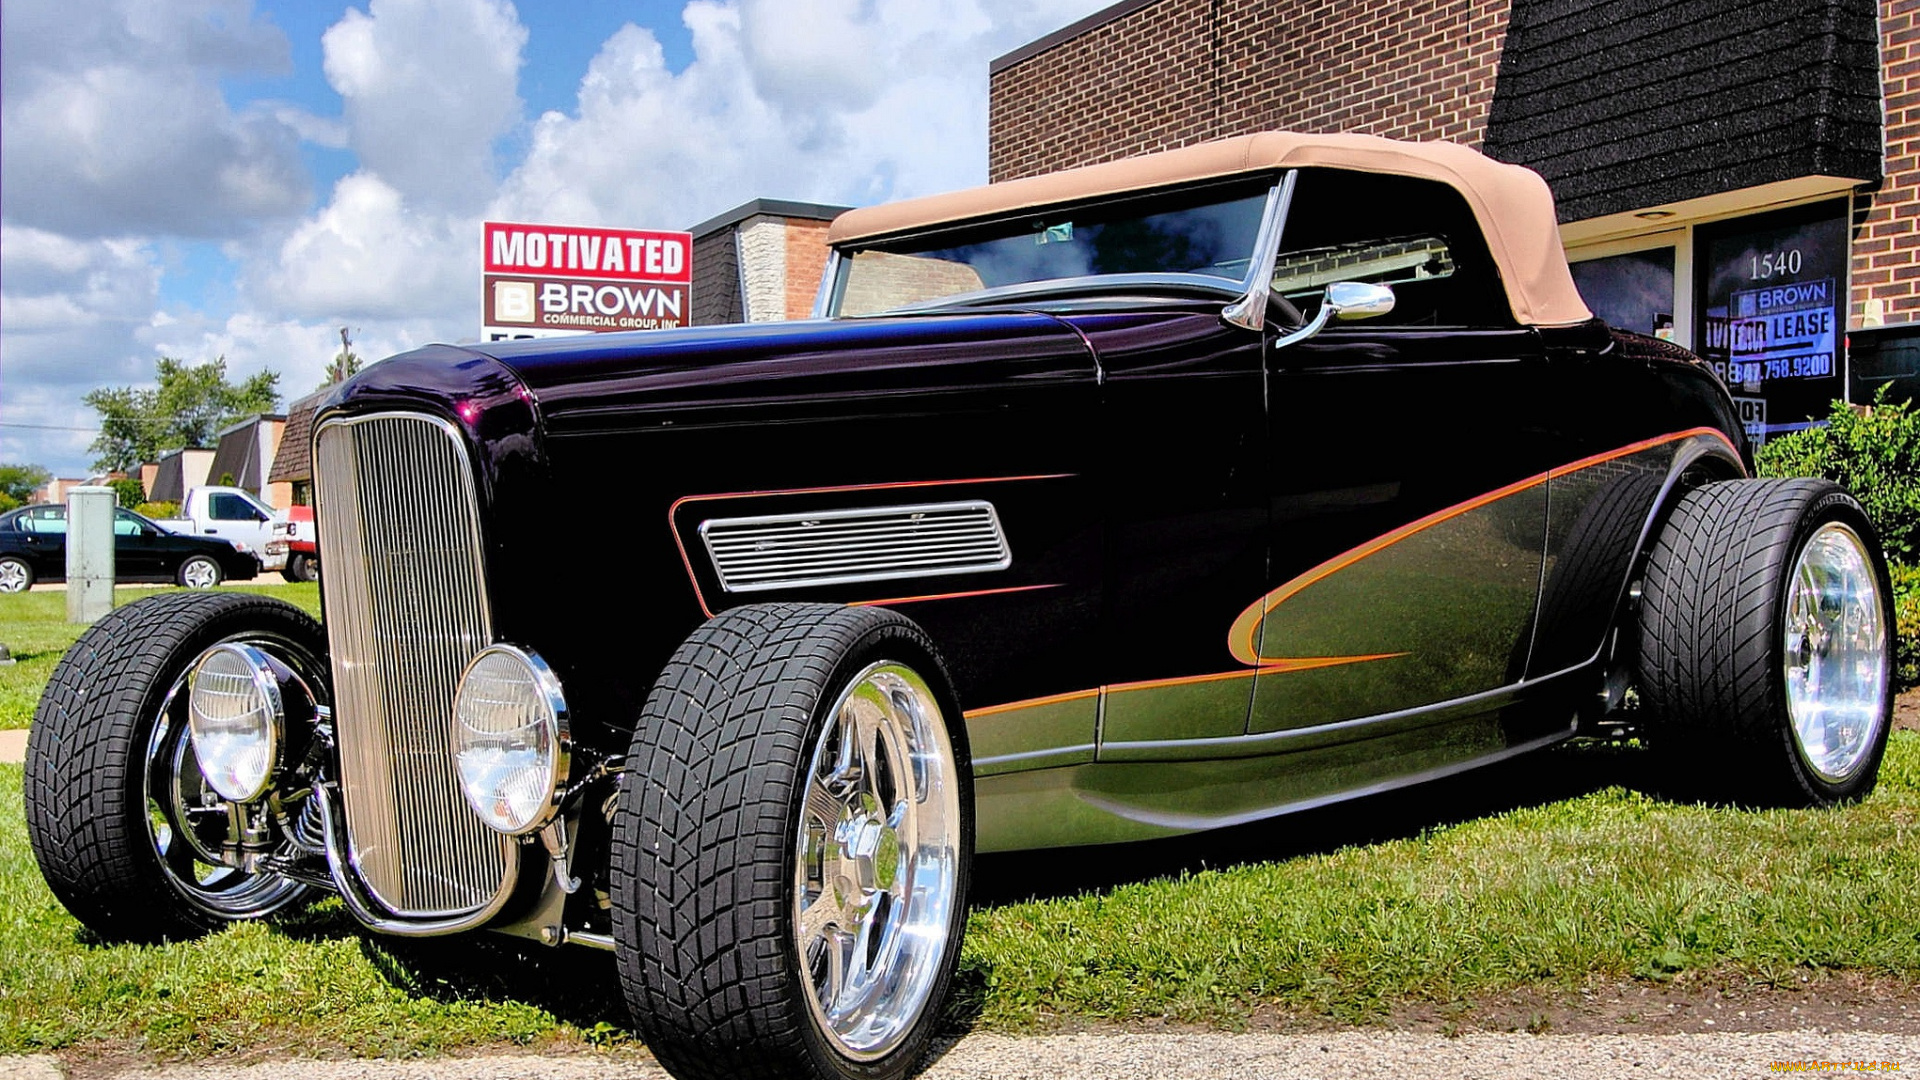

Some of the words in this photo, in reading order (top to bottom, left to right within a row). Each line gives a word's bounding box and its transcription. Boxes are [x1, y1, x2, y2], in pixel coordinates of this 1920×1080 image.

[492, 231, 684, 275] MOTIVATED
[1750, 250, 1801, 280] 1540
[502, 287, 530, 317] B
[540, 283, 680, 318] BROWN
[1759, 282, 1826, 309] BROWN
[543, 313, 617, 327] COMMERCIAL
[1774, 311, 1829, 339] LEASE
